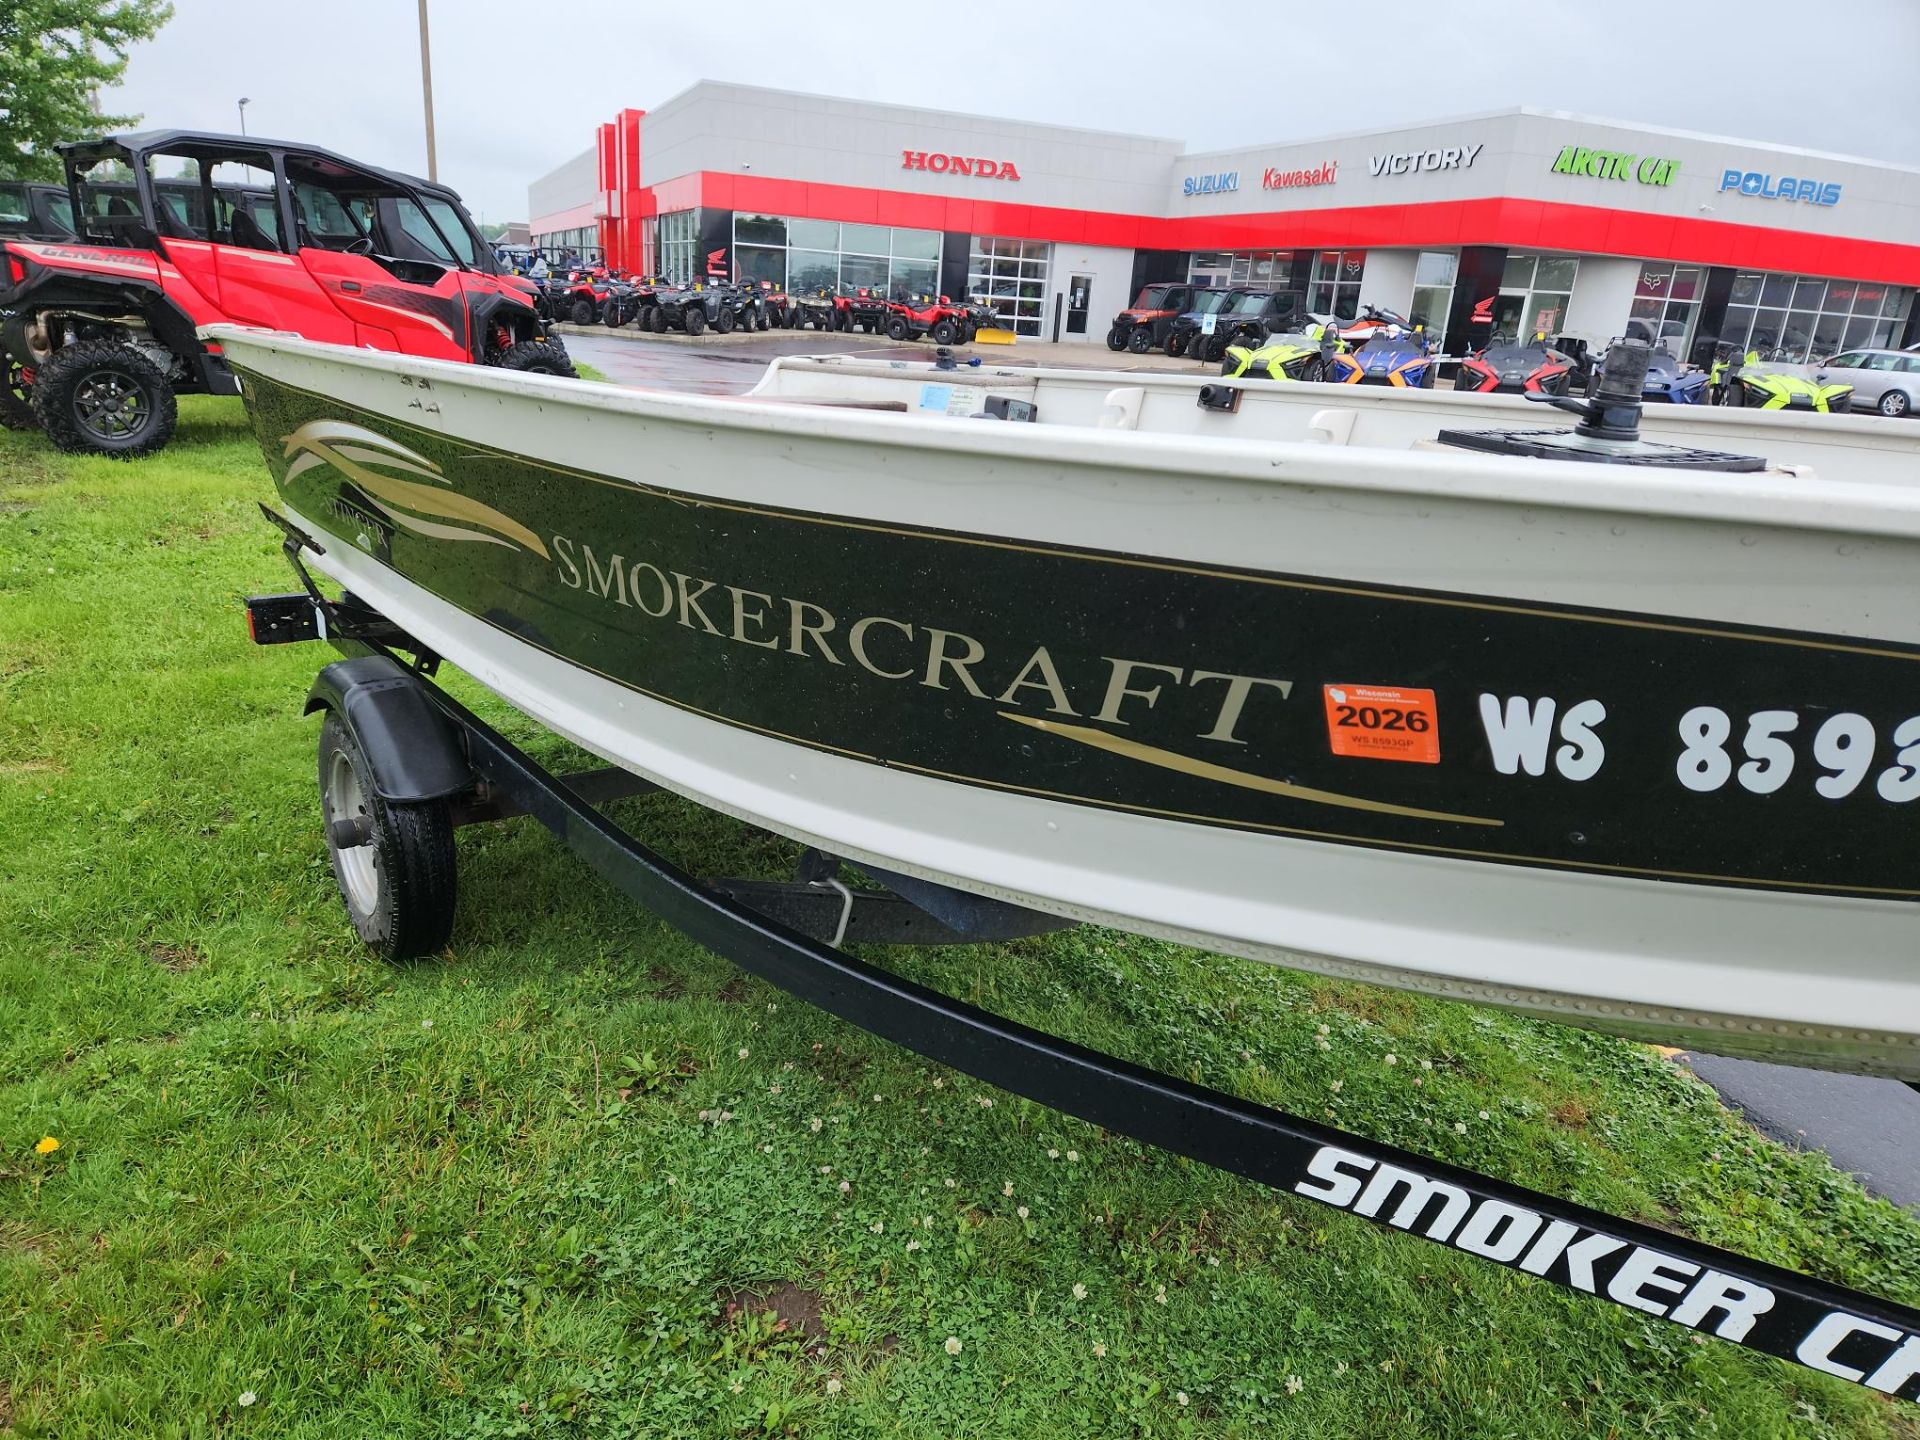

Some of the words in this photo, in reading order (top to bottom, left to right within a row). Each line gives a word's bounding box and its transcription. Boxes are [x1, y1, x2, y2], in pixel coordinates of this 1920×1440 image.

[903, 150, 1020, 181] HONDA
[1262, 161, 1338, 190] Kawasaki
[1369, 145, 1483, 176] VICTORY
[1552, 146, 1637, 181] ARCTIC
[1638, 157, 1681, 187] CAT
[1184, 172, 1239, 196] SUZUKI
[1720, 169, 1842, 206] POLARIS
[550, 533, 1293, 746] SMOKERCRAFT
[1355, 688, 1401, 699] Wisconsin
[1335, 705, 1430, 733] 2026
[1478, 692, 1608, 782] WS
[1295, 1146, 1777, 1343] SMOKER
